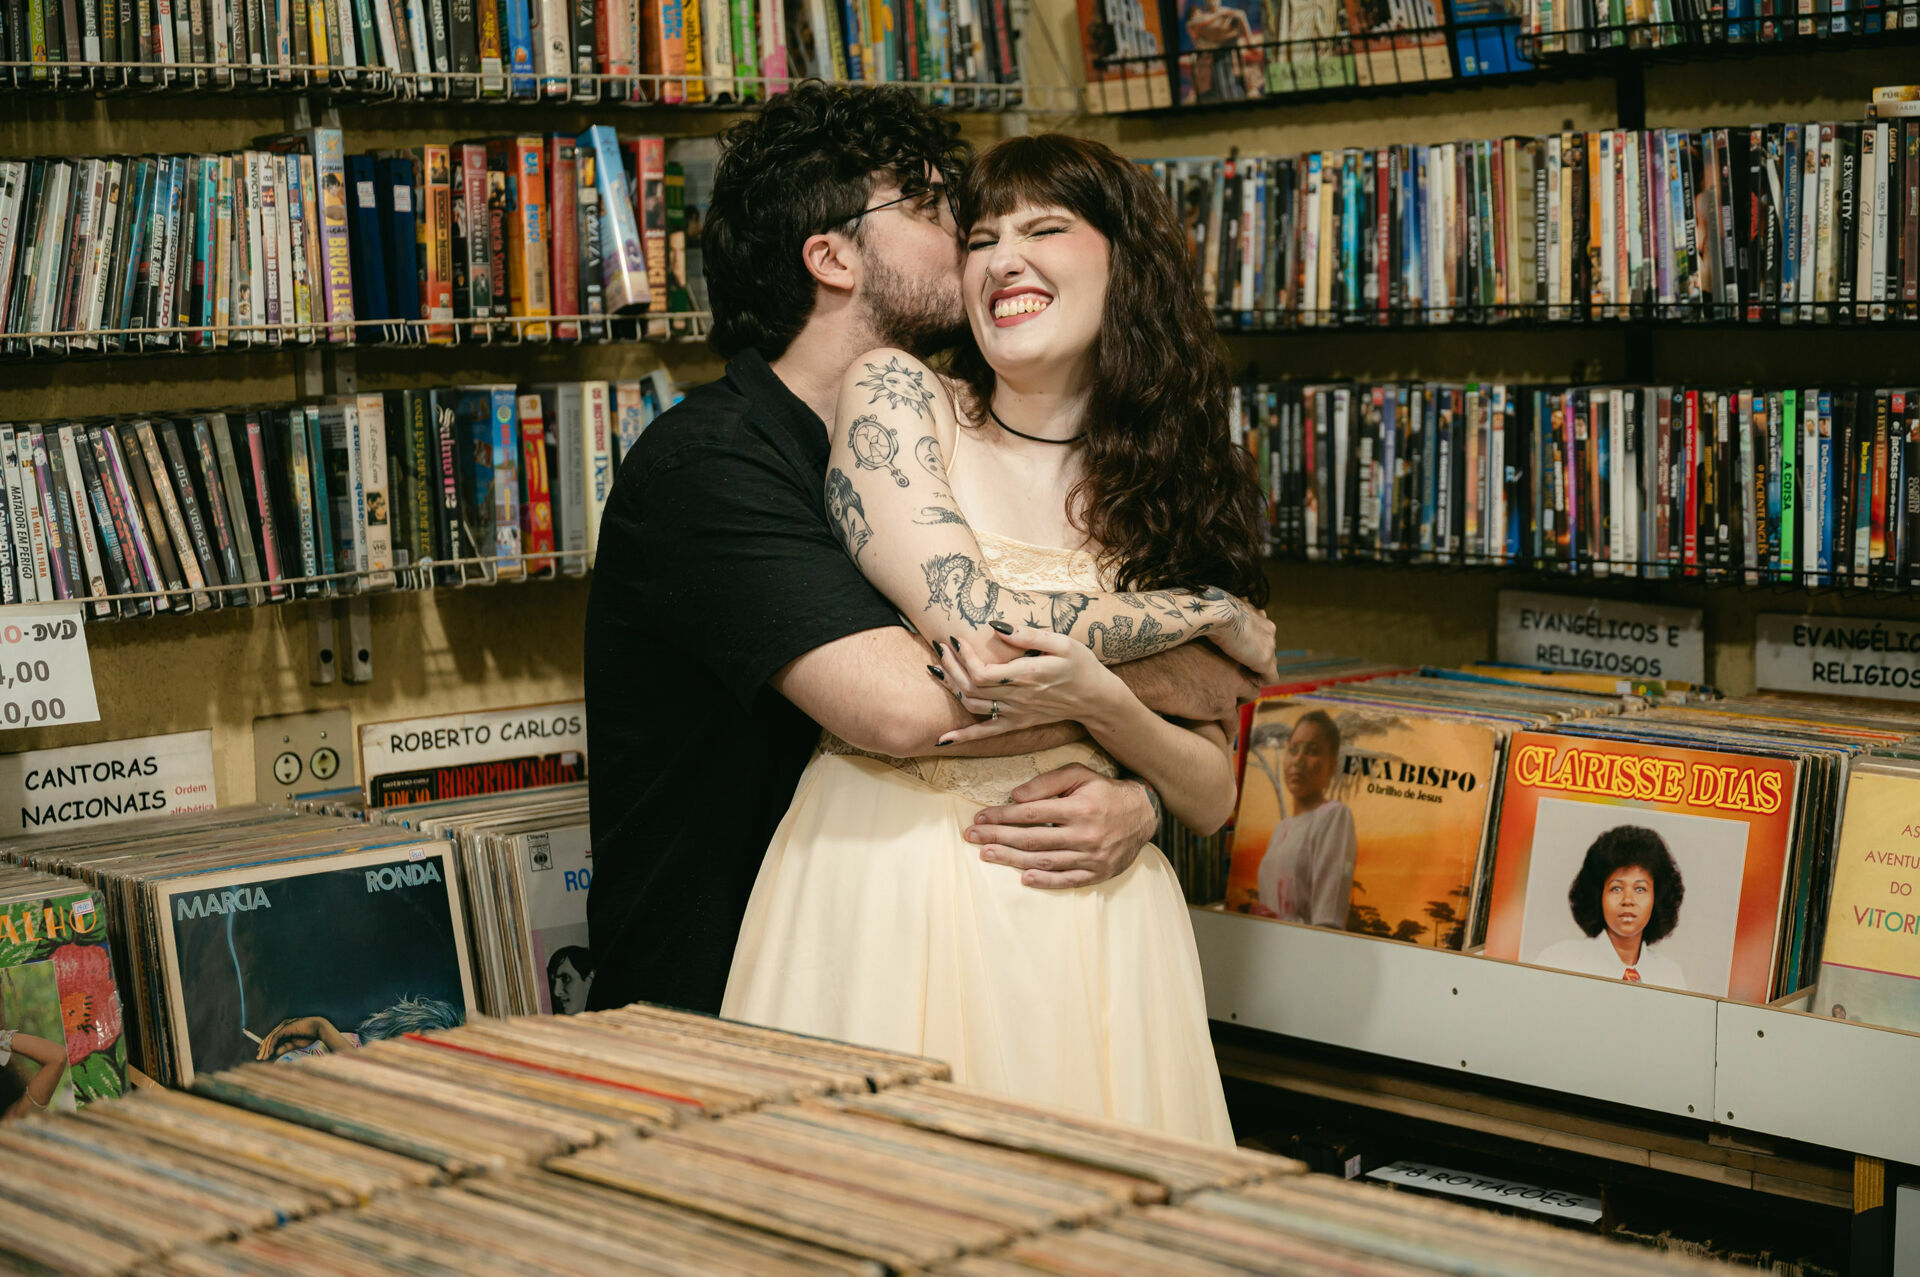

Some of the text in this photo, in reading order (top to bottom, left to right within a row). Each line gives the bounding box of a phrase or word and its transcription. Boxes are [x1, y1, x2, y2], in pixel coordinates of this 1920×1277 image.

[103, 0, 116, 39] HUR
[1843, 154, 1854, 177] SEX
[250, 162, 260, 209] INVICTUS
[1842, 189, 1853, 220] CITY
[152, 214, 164, 248] GARRAS
[153, 248, 162, 261] DE
[161, 215, 181, 327] arriscando TUDO
[328, 237, 352, 316] BRUCE LEE
[1876, 415, 1886, 441] VENTO
[433, 403, 457, 510] Salmo 112
[1890, 435, 1902, 480] jackass
[594, 455, 609, 503] Deus
[1755, 473, 1766, 517] PACIENTE
[1783, 461, 1792, 511] A COISA
[30, 506, 39, 520] TAL
[75, 490, 87, 519] REBELDE
[83, 532, 94, 553] CAUSA
[298, 474, 316, 577] OLHO POR OLHO
[11, 486, 33, 579] MATADOR EM PERIGO
[35, 542, 45, 555] TAL
[58, 486, 73, 535] JOVENS
[67, 549, 81, 581] FUGA
[189, 507, 211, 562] VORAZES
[1756, 519, 1769, 555] INGLÊS
[37, 557, 48, 578] FILHA
[1520, 609, 1680, 647] EVANGÉLICOS E
[1536, 644, 1663, 677] RELIGIOSOS
[0, 698, 66, 727] 0,00
[391, 716, 582, 753] ROBERTO CARLOS
[25, 757, 158, 791] CANTORAS
[175, 783, 207, 795] Ordem
[438, 762, 516, 800] ROBERTO
[1343, 755, 1477, 793] EVA BISPO
[1515, 743, 1783, 815] CLARISSE DIAS
[21, 790, 167, 828] NACIONAIS
[170, 803, 215, 816] alfabética
[1367, 783, 1443, 804] O brilho de Jesus
[365, 861, 442, 893] RONDA
[1864, 850, 1920, 869] AVENTU
[564, 868, 593, 892] RO
[1890, 881, 1912, 896] DO
[178, 886, 271, 921] MARCIA
[1391, 1164, 1584, 1208] 78 ROTAÇÕES
